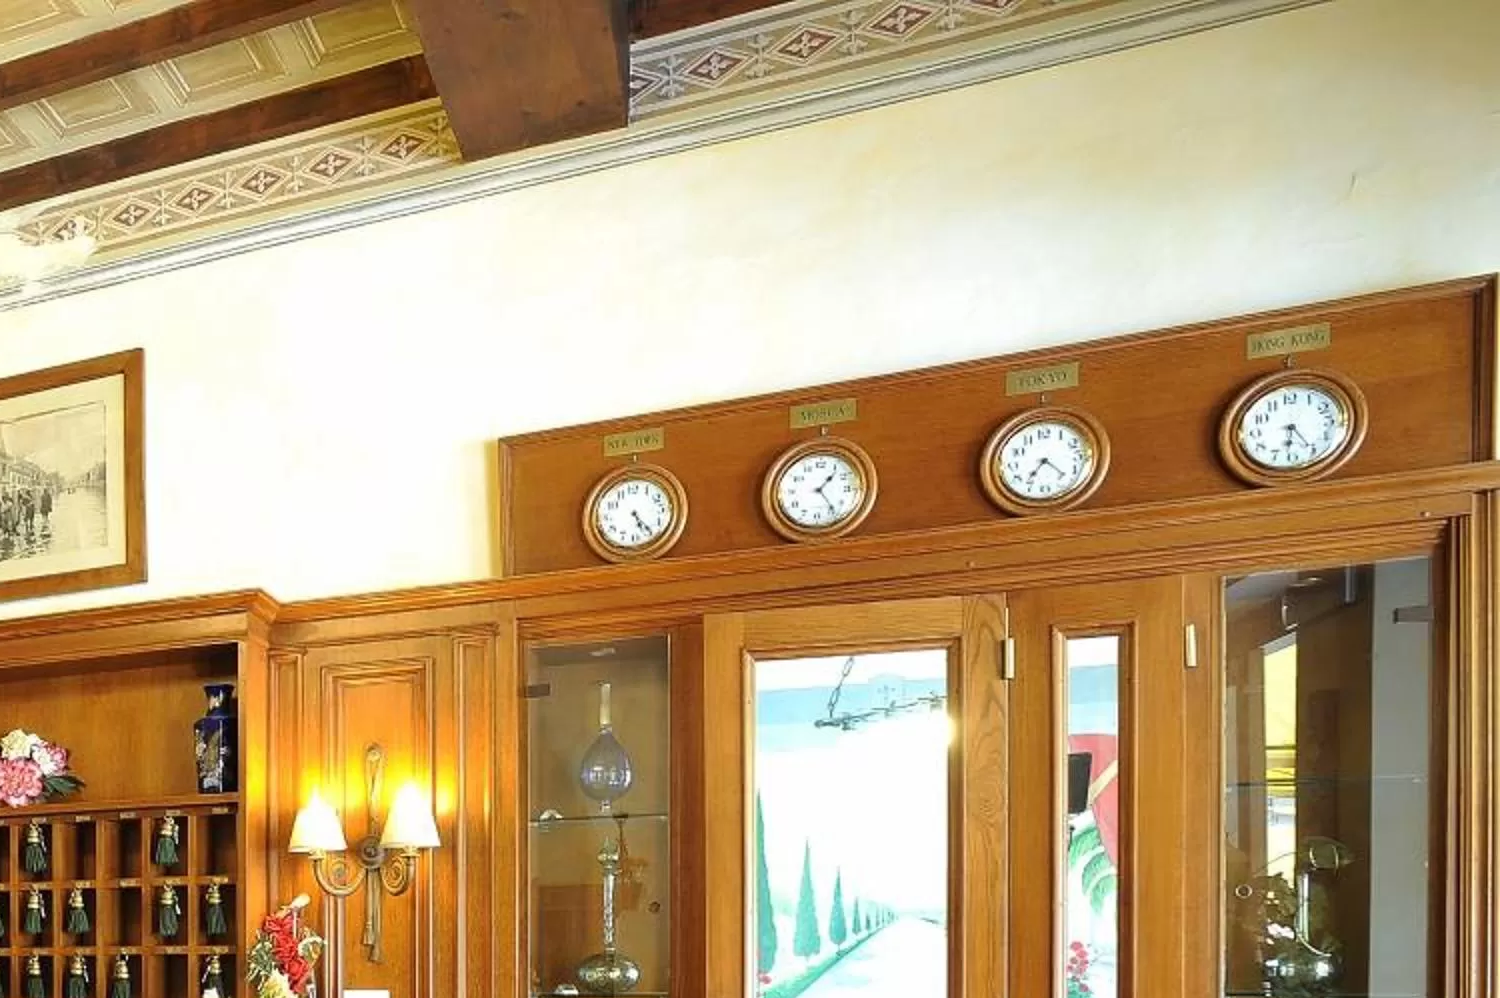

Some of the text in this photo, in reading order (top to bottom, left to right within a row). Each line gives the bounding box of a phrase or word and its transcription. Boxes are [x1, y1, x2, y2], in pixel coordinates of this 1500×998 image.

[1291, 328, 1325, 347] KONG
[1283, 393, 1297, 405] 12
[1037, 428, 1051, 440] 12
